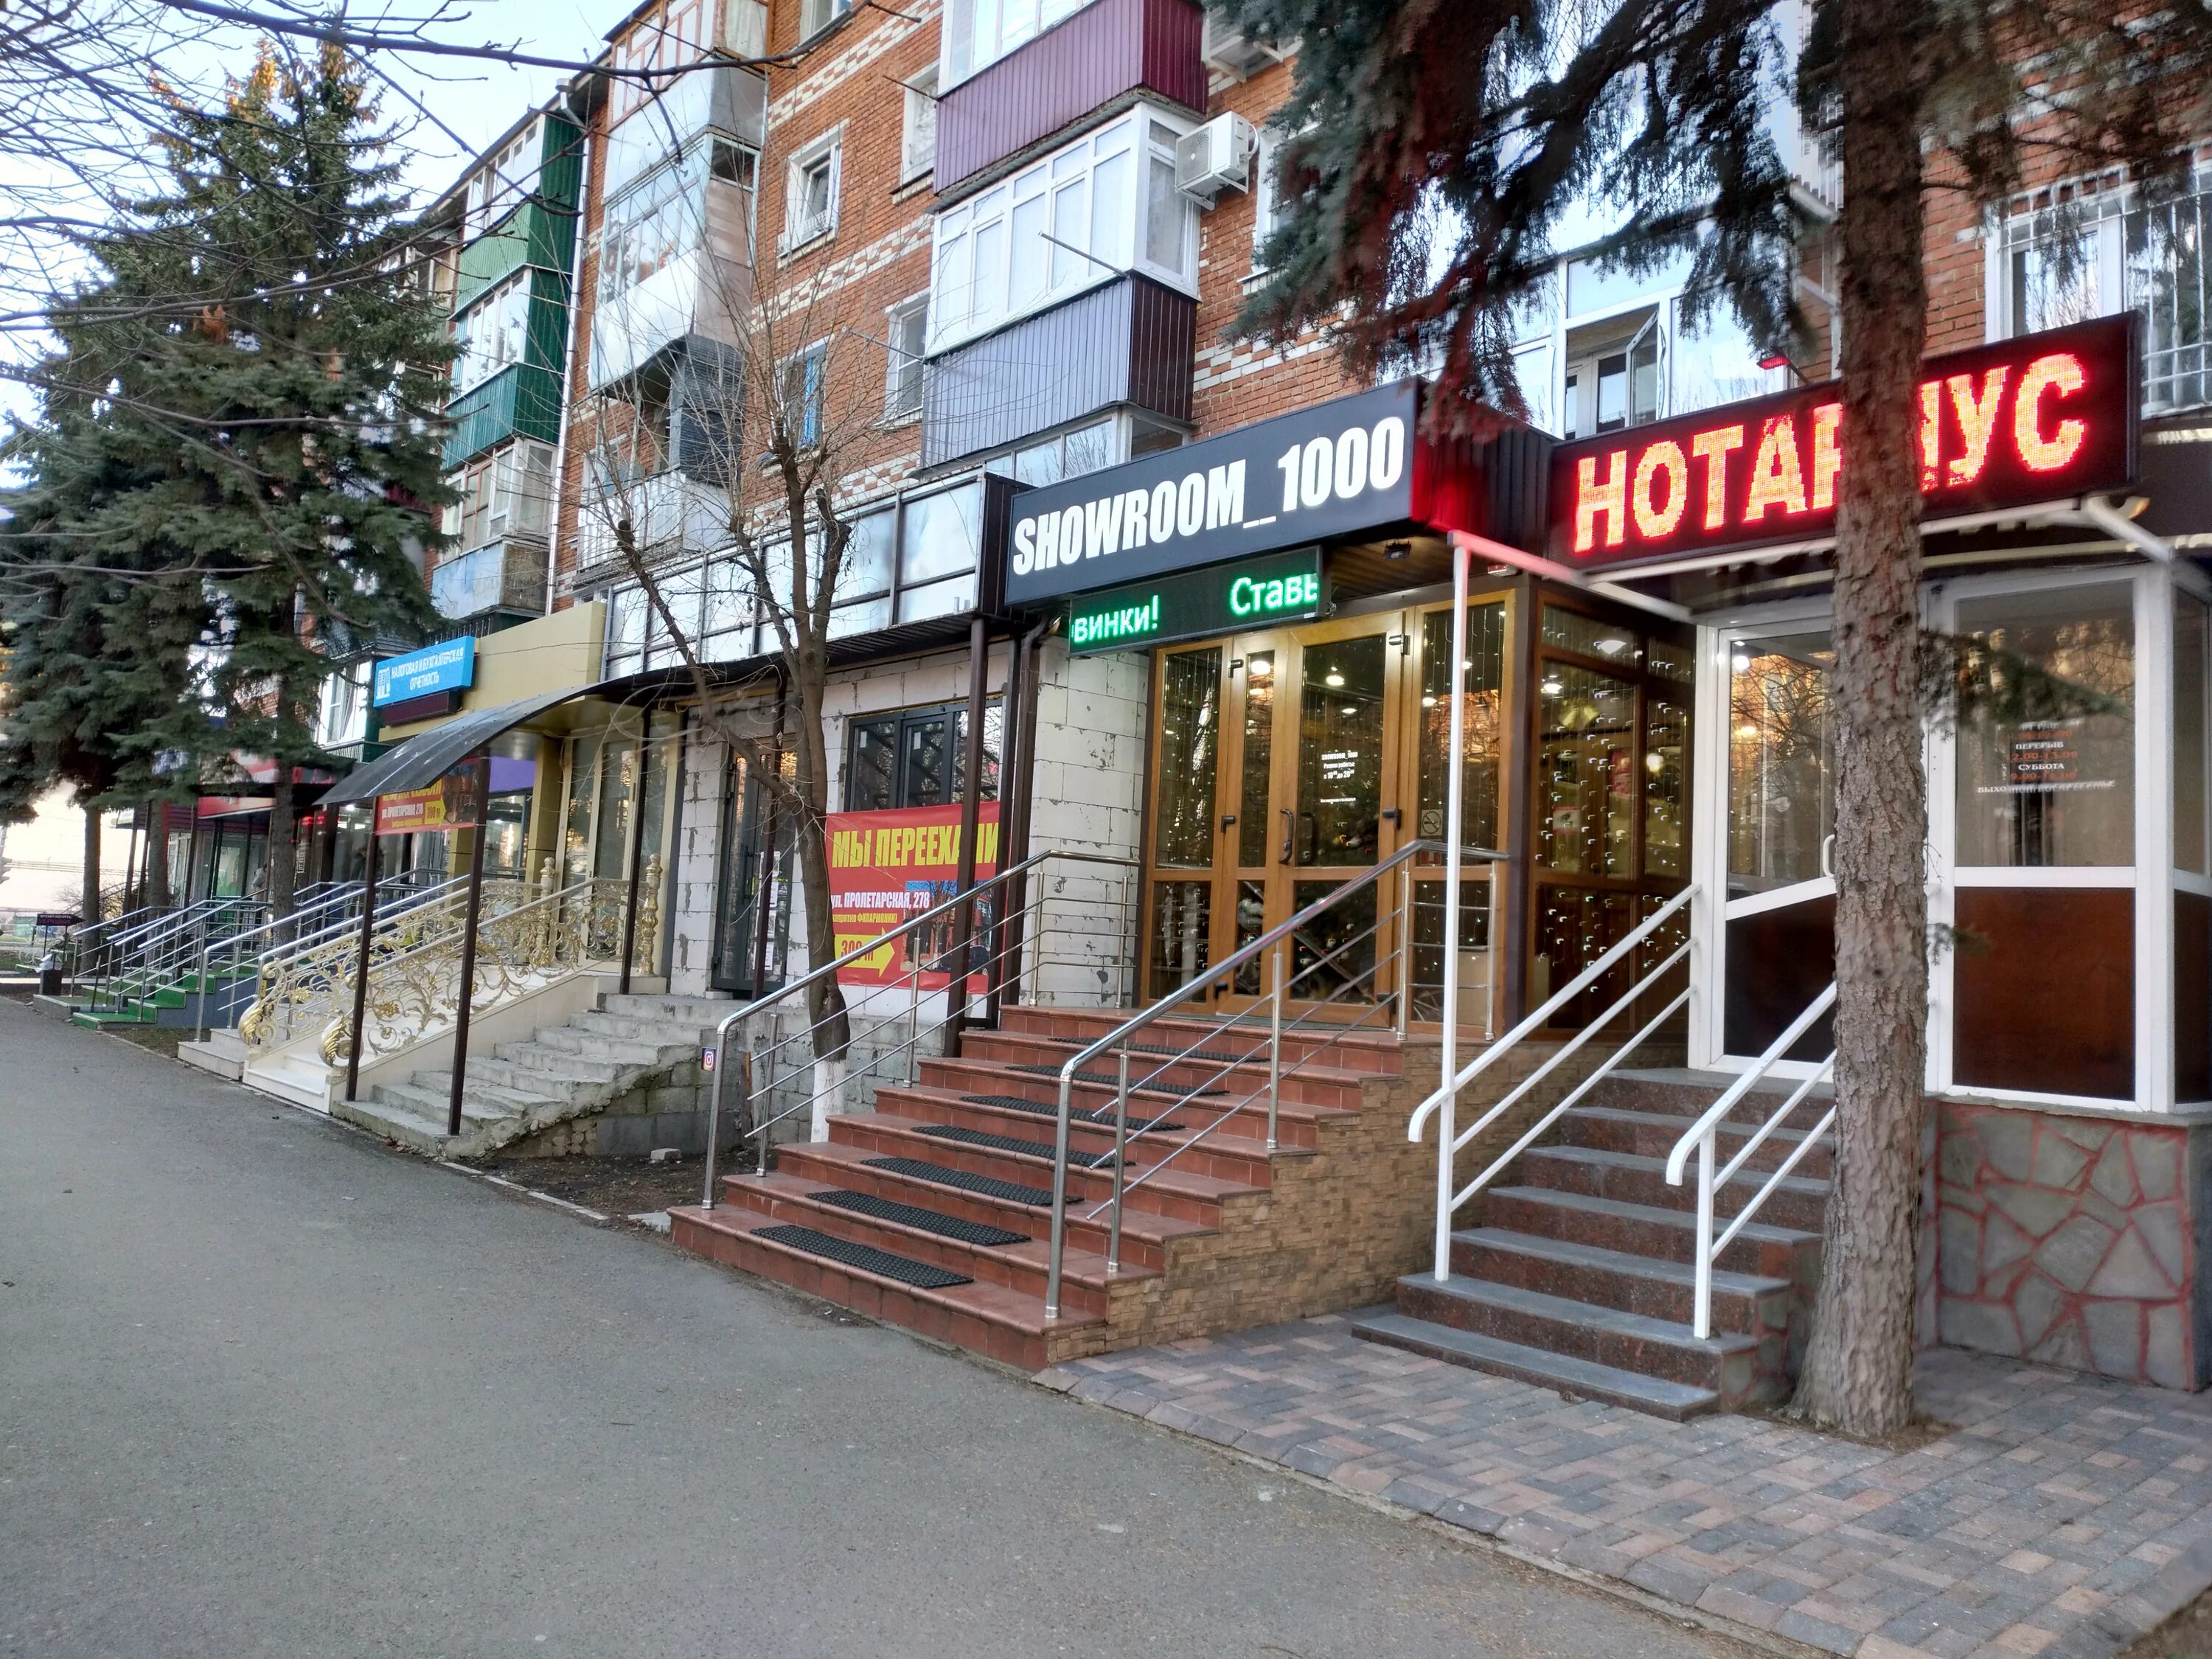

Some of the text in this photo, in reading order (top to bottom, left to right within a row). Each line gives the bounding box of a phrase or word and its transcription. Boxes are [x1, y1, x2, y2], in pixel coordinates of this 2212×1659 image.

[1012, 416, 1405, 575] SHOWROOM_1000
[1071, 594, 1159, 643] винки!
[2015, 742, 2064, 750] ПЕРЕРЫВ
[2018, 762, 2065, 771] СУББОТА
[832, 830, 872, 868] МЫ
[831, 891, 930, 909] ул. ПРОЛЕТАРСКАЯ, 278
